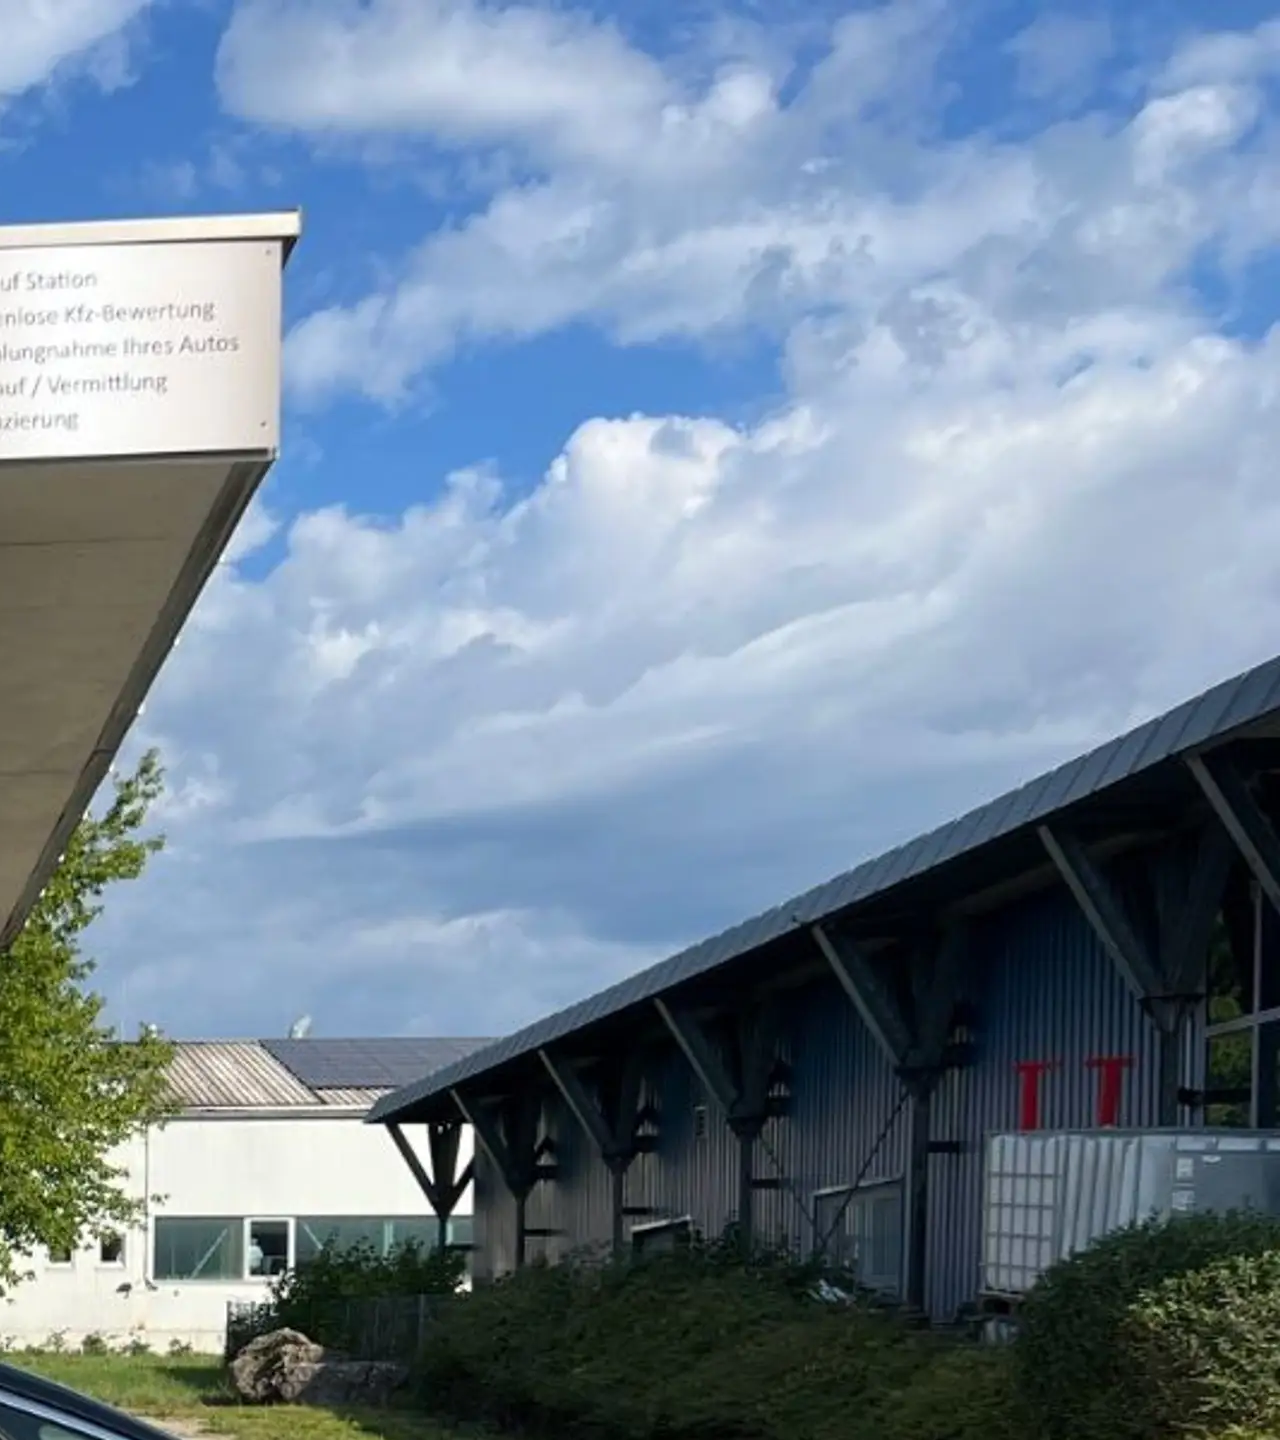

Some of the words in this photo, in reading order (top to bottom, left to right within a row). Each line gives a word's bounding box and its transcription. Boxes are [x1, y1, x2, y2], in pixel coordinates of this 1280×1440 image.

[26, 270, 98, 291] Station
[64, 301, 216, 324] Kfz-Bewertung
[122, 336, 174, 358] Ihres
[177, 334, 240, 355] Autos
[46, 370, 170, 396] Vermittlung
